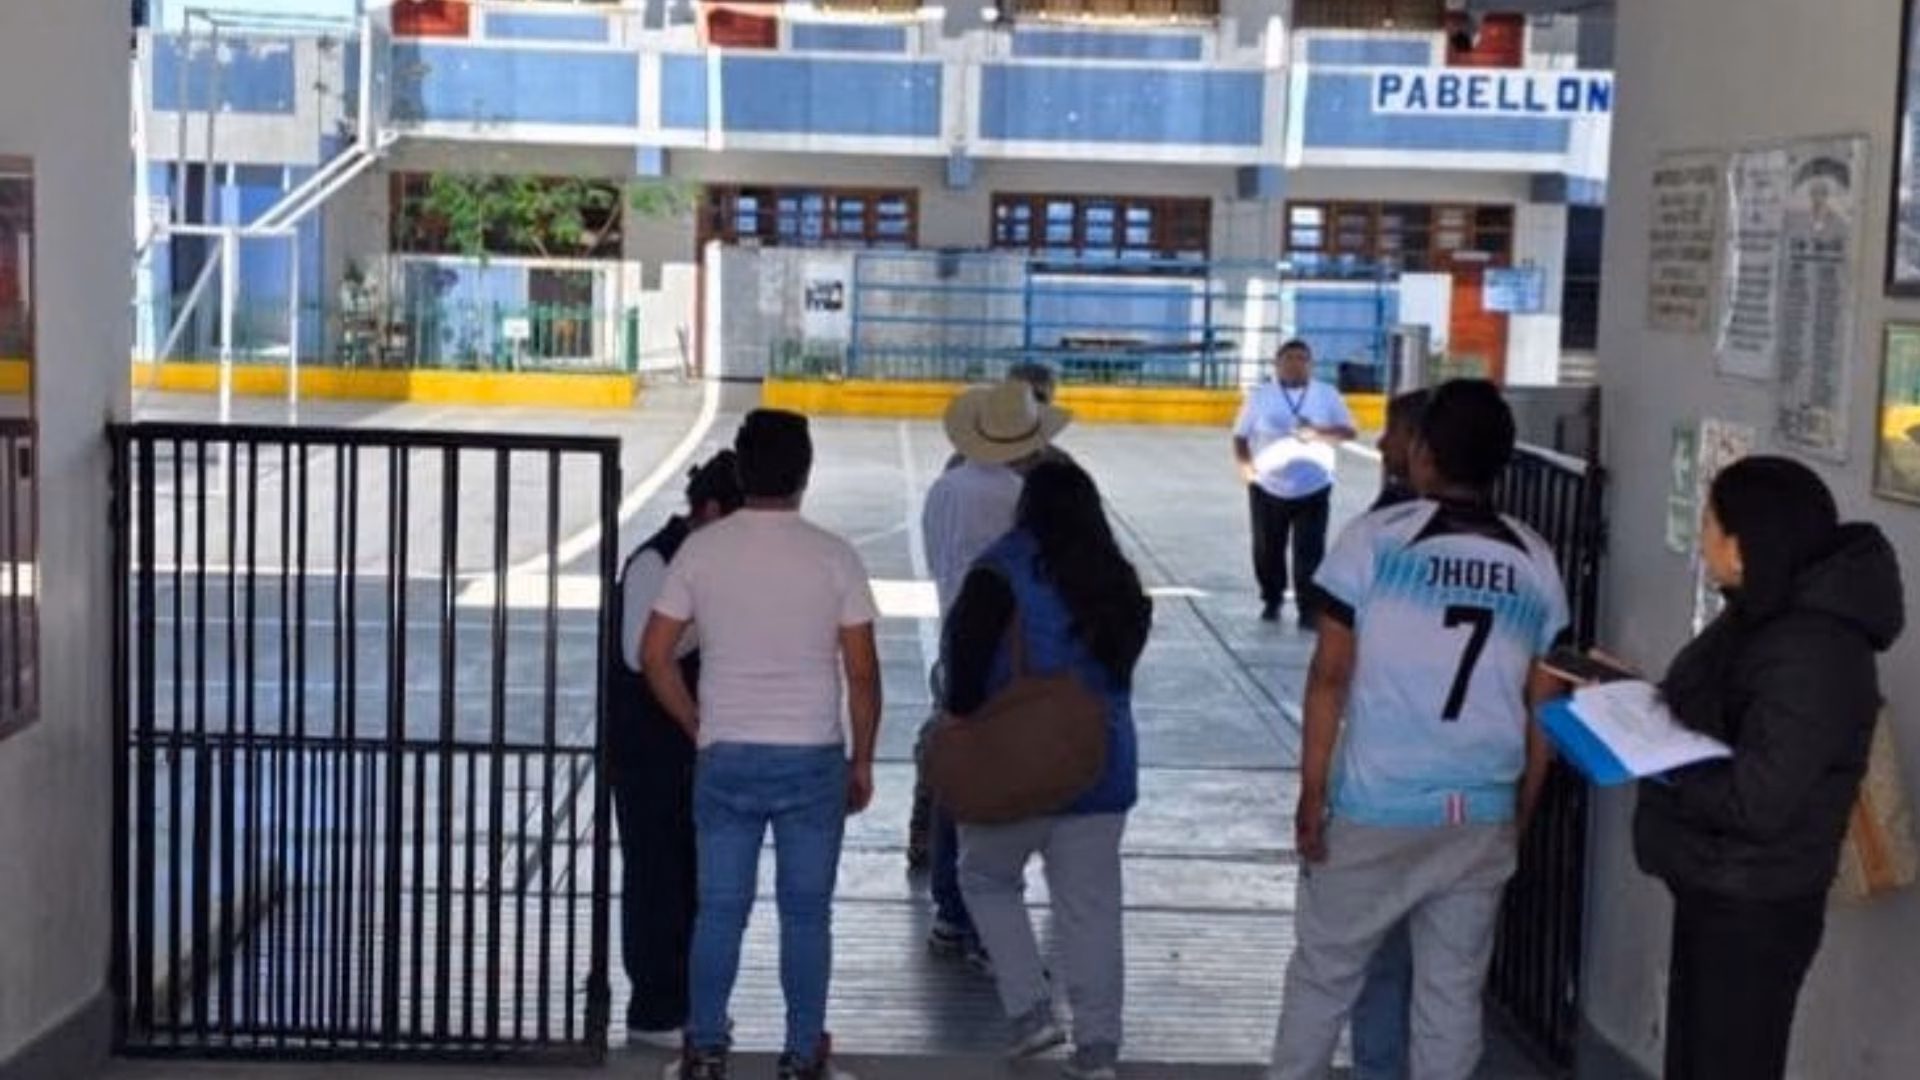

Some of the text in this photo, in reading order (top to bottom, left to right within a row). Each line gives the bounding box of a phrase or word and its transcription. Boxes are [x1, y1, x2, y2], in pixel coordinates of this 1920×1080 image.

[1377, 73, 1611, 112] PABELLON
[1427, 556, 1518, 596] JHOEL
[1441, 605, 1495, 722] 7
